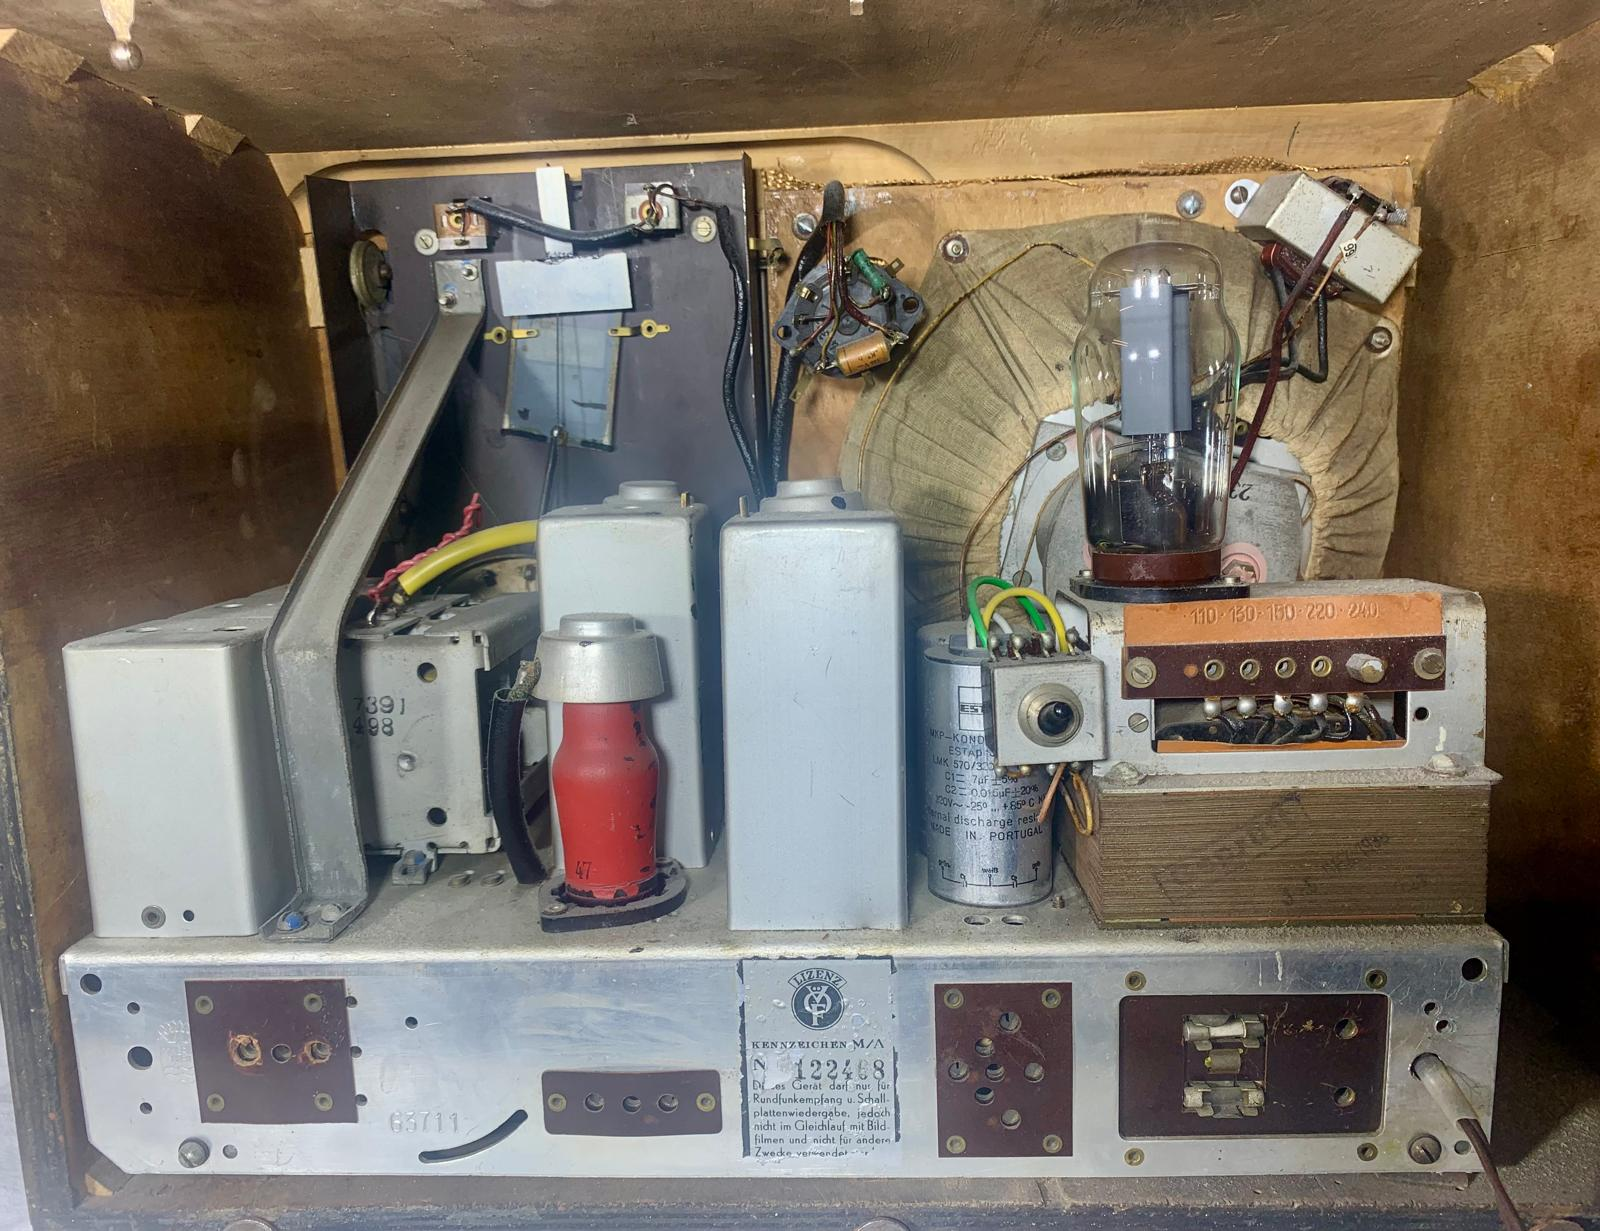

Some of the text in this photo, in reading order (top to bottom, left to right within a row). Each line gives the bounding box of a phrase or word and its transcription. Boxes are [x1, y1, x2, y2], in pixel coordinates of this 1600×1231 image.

[954, 815, 1013, 829] discharge
[965, 831, 977, 841] IN
[989, 826, 1043, 842] PORTUGAL
[793, 969, 843, 986] LIZENZ
[751, 1040, 847, 1049] KENNZEICHEN
[829, 1079, 849, 1092] darf
[877, 1079, 891, 1091] für
[753, 1093, 843, 1106] Rundfunkempfang
[857, 1107, 891, 1119] jedoch
[753, 1120, 777, 1131] nicht
[780, 1121, 792, 1131] im
[794, 1119, 846, 1132] Gleichlauf
[850, 1121, 865, 1132] mit
[754, 1134, 785, 1145] filmen
[789, 1133, 807, 1144] und
[813, 1133, 836, 1144] nicht
[839, 1134, 852, 1145] für
